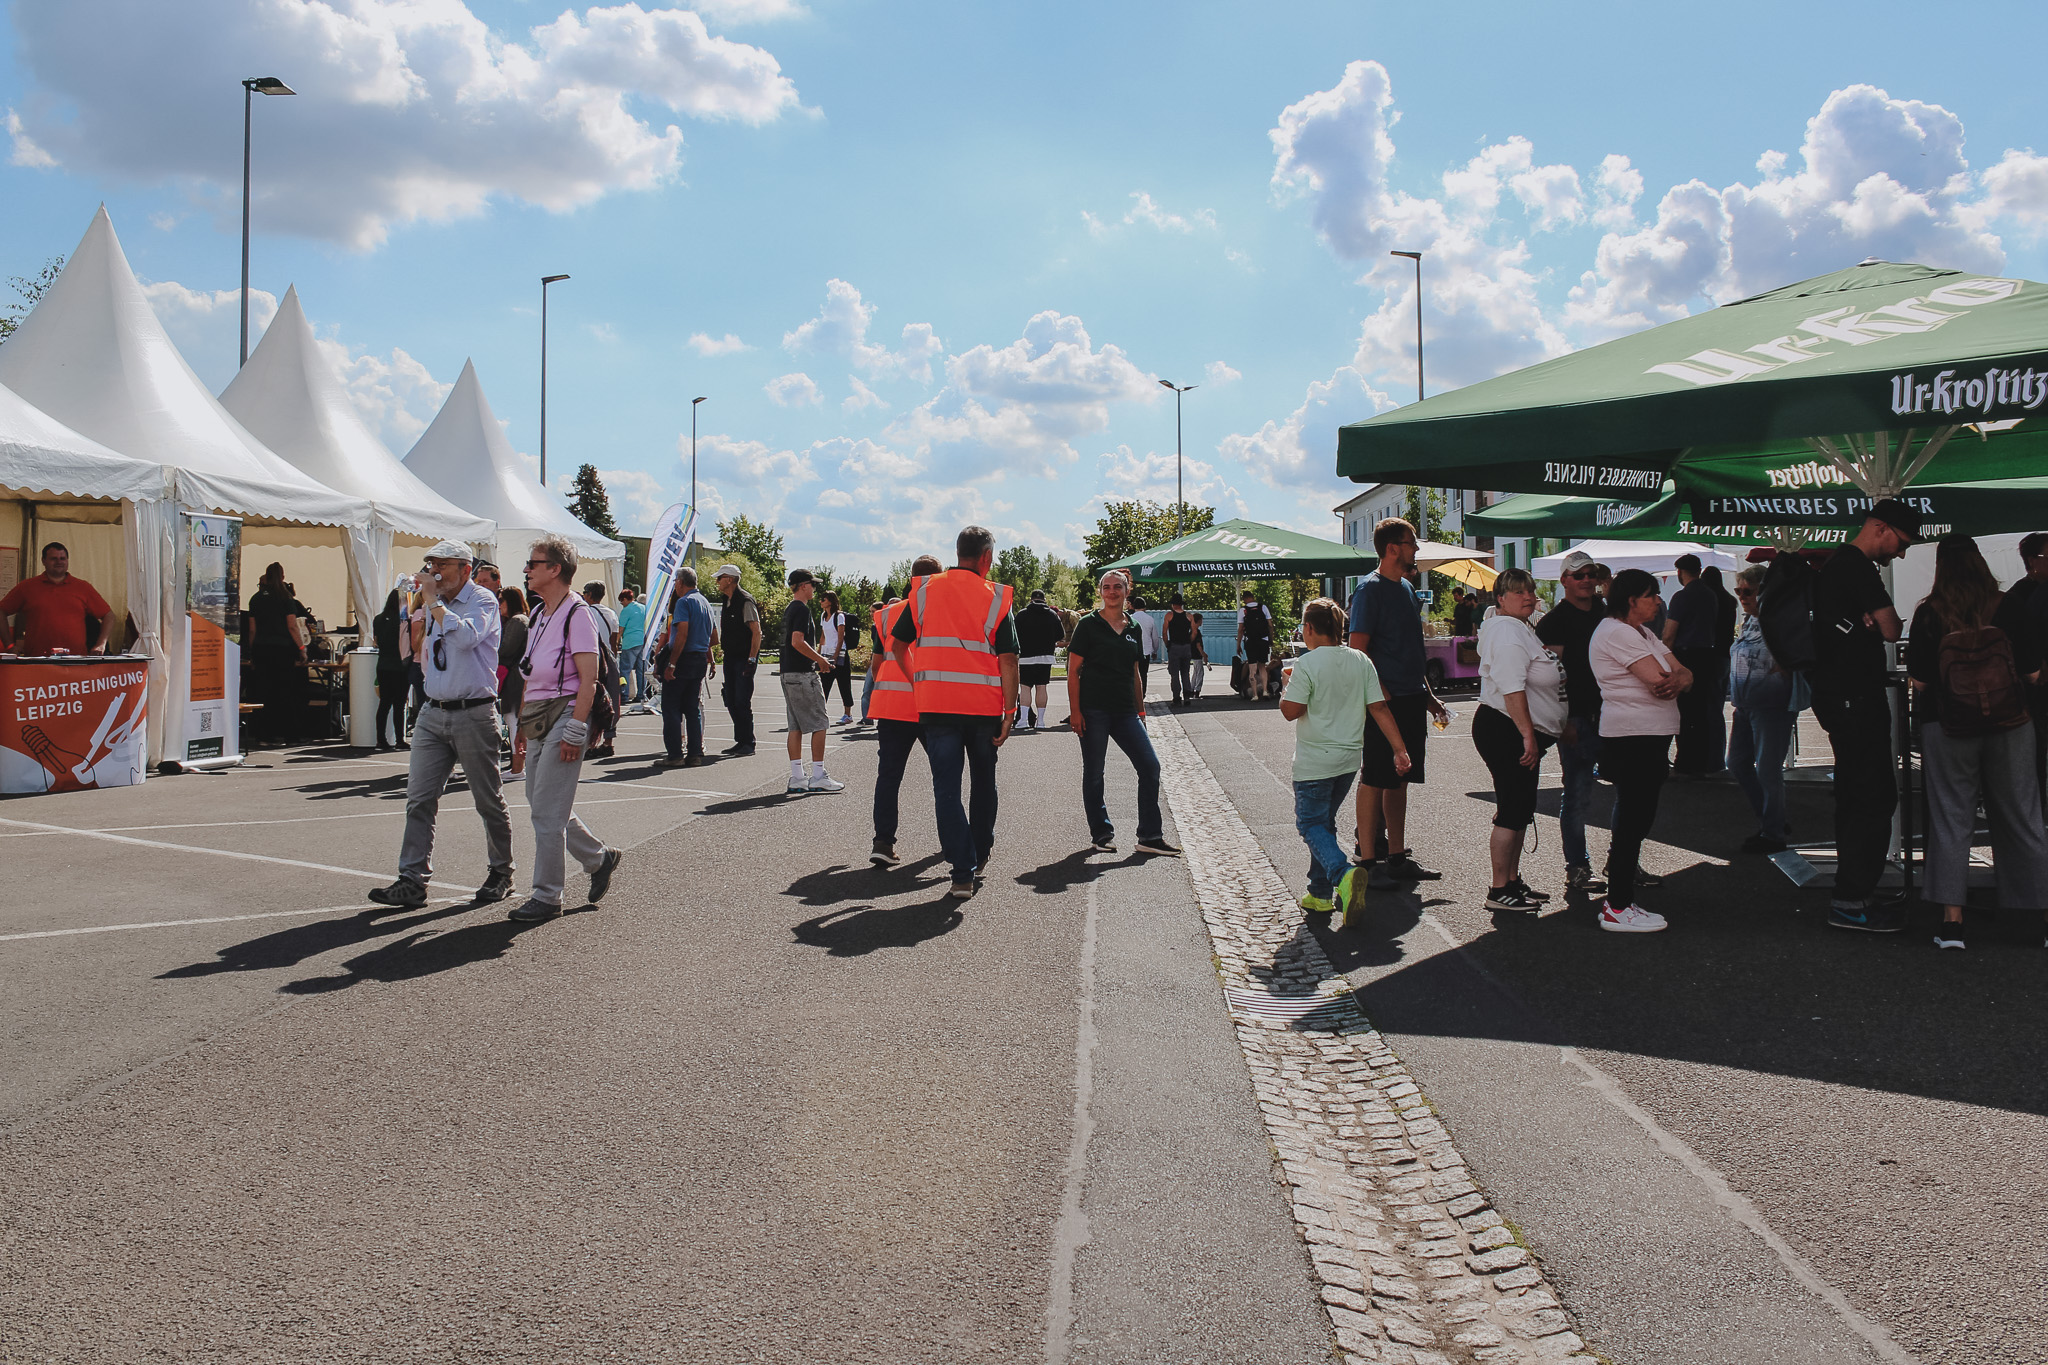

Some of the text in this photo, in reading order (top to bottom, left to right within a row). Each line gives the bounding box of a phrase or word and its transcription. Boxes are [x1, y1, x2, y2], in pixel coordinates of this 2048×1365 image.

[1709, 497, 1935, 515] FEINHERBES PILER
[201, 534, 226, 547] KELL
[657, 523, 687, 576] WEV
[1176, 562, 1277, 572] FEINHERBES PILSNER
[14, 670, 144, 703] STADTREINIGUNG
[16, 700, 83, 721] LEIPZIG
